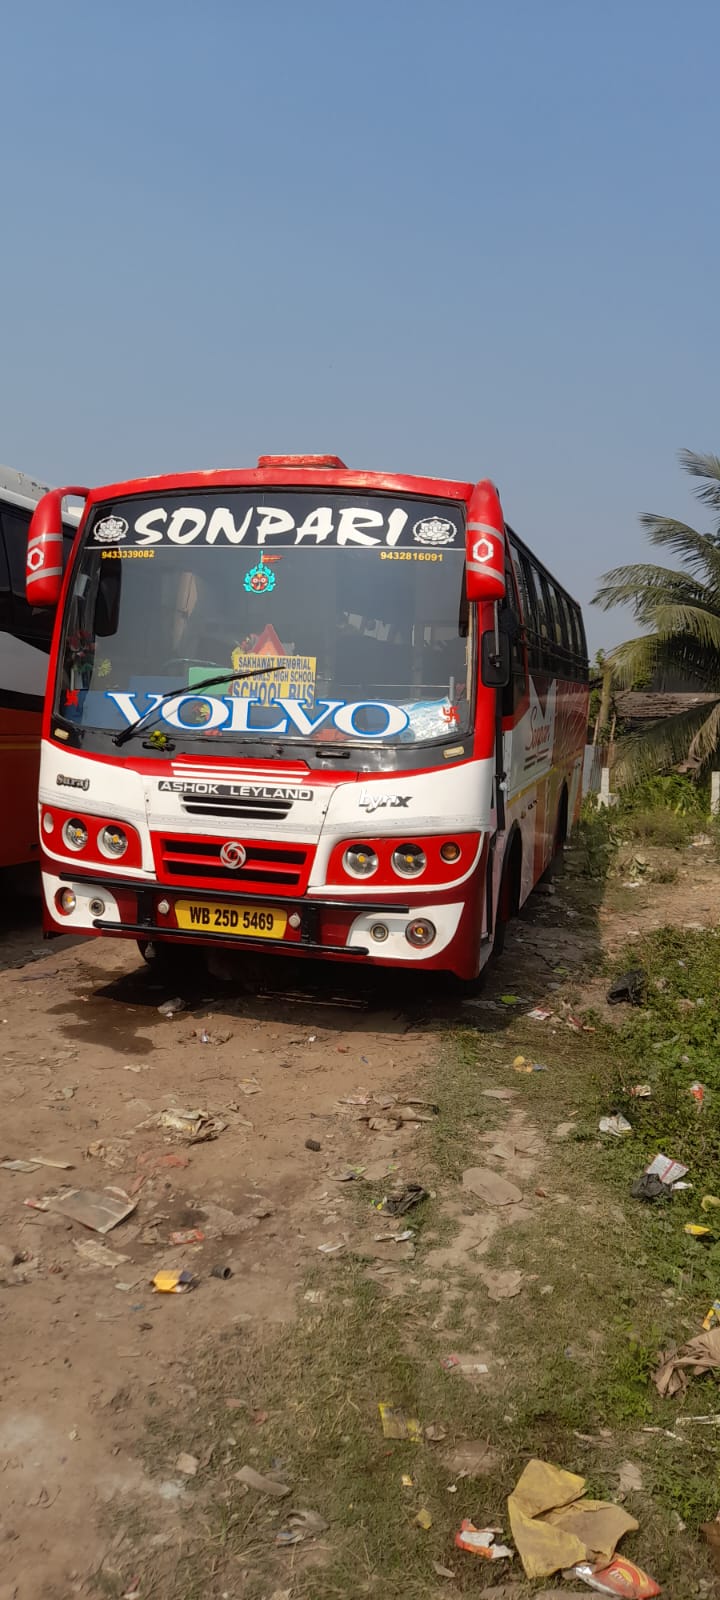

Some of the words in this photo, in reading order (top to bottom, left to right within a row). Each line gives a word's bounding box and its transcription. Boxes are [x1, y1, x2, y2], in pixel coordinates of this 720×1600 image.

[134, 507, 408, 545] SONPARI
[101, 550, 155, 559] 9433339082
[380, 551, 444, 562] 9432816091
[238, 656, 274, 669] SAKHAWAT
[277, 657, 310, 669] MEMORIAL
[273, 671, 289, 682] HIGH
[290, 671, 316, 683] SCHOOL
[233, 681, 280, 705] SCHOOL
[288, 683, 315, 708] BUS
[106, 692, 410, 738] VOLVO
[56, 774, 90, 791] Suraj
[160, 781, 219, 794] ASHOK
[230, 785, 311, 800] LEYLAND
[190, 906, 210, 925] WB
[214, 908, 239, 927] 25D
[243, 911, 274, 931] 5469
